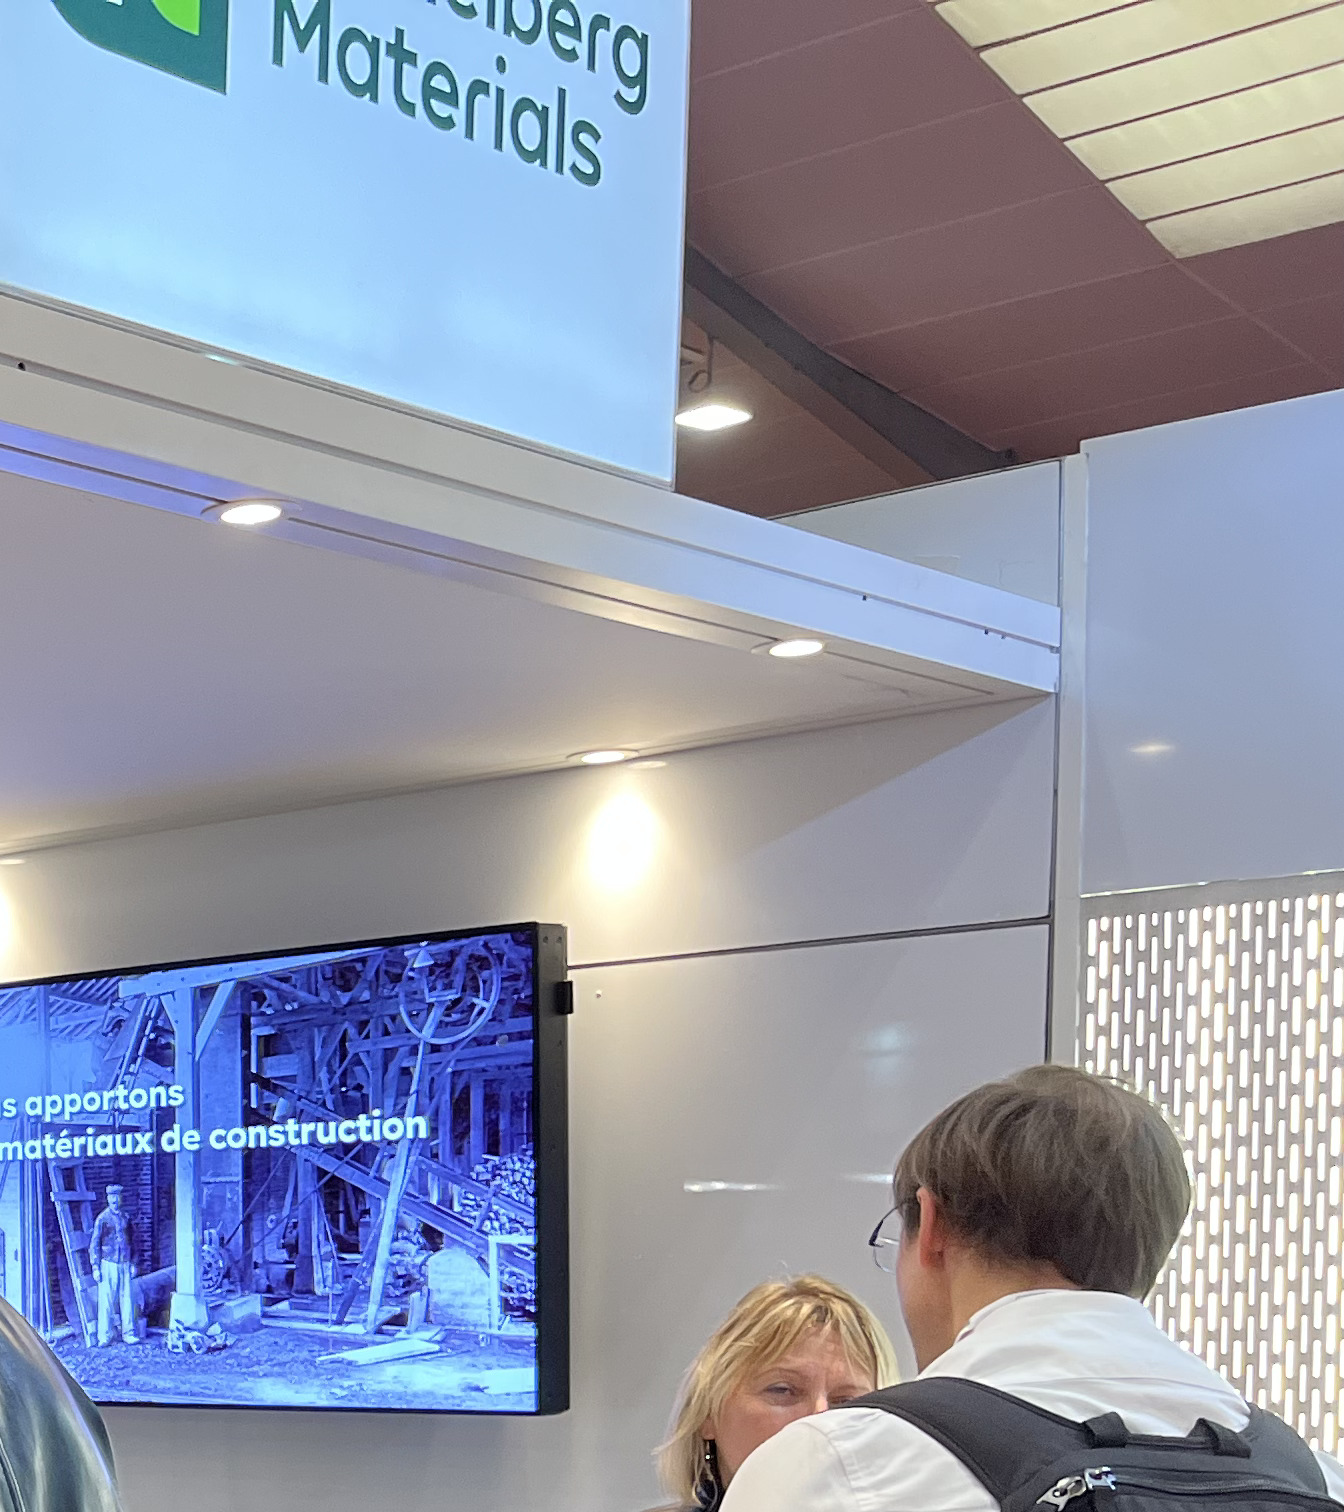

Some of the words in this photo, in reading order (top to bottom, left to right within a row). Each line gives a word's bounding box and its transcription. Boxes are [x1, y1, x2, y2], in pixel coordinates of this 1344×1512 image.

[272, 0, 602, 187] Materials
[25, 1084, 185, 1122] apportons
[160, 1123, 201, 1152] de
[208, 1109, 429, 1152] construction
